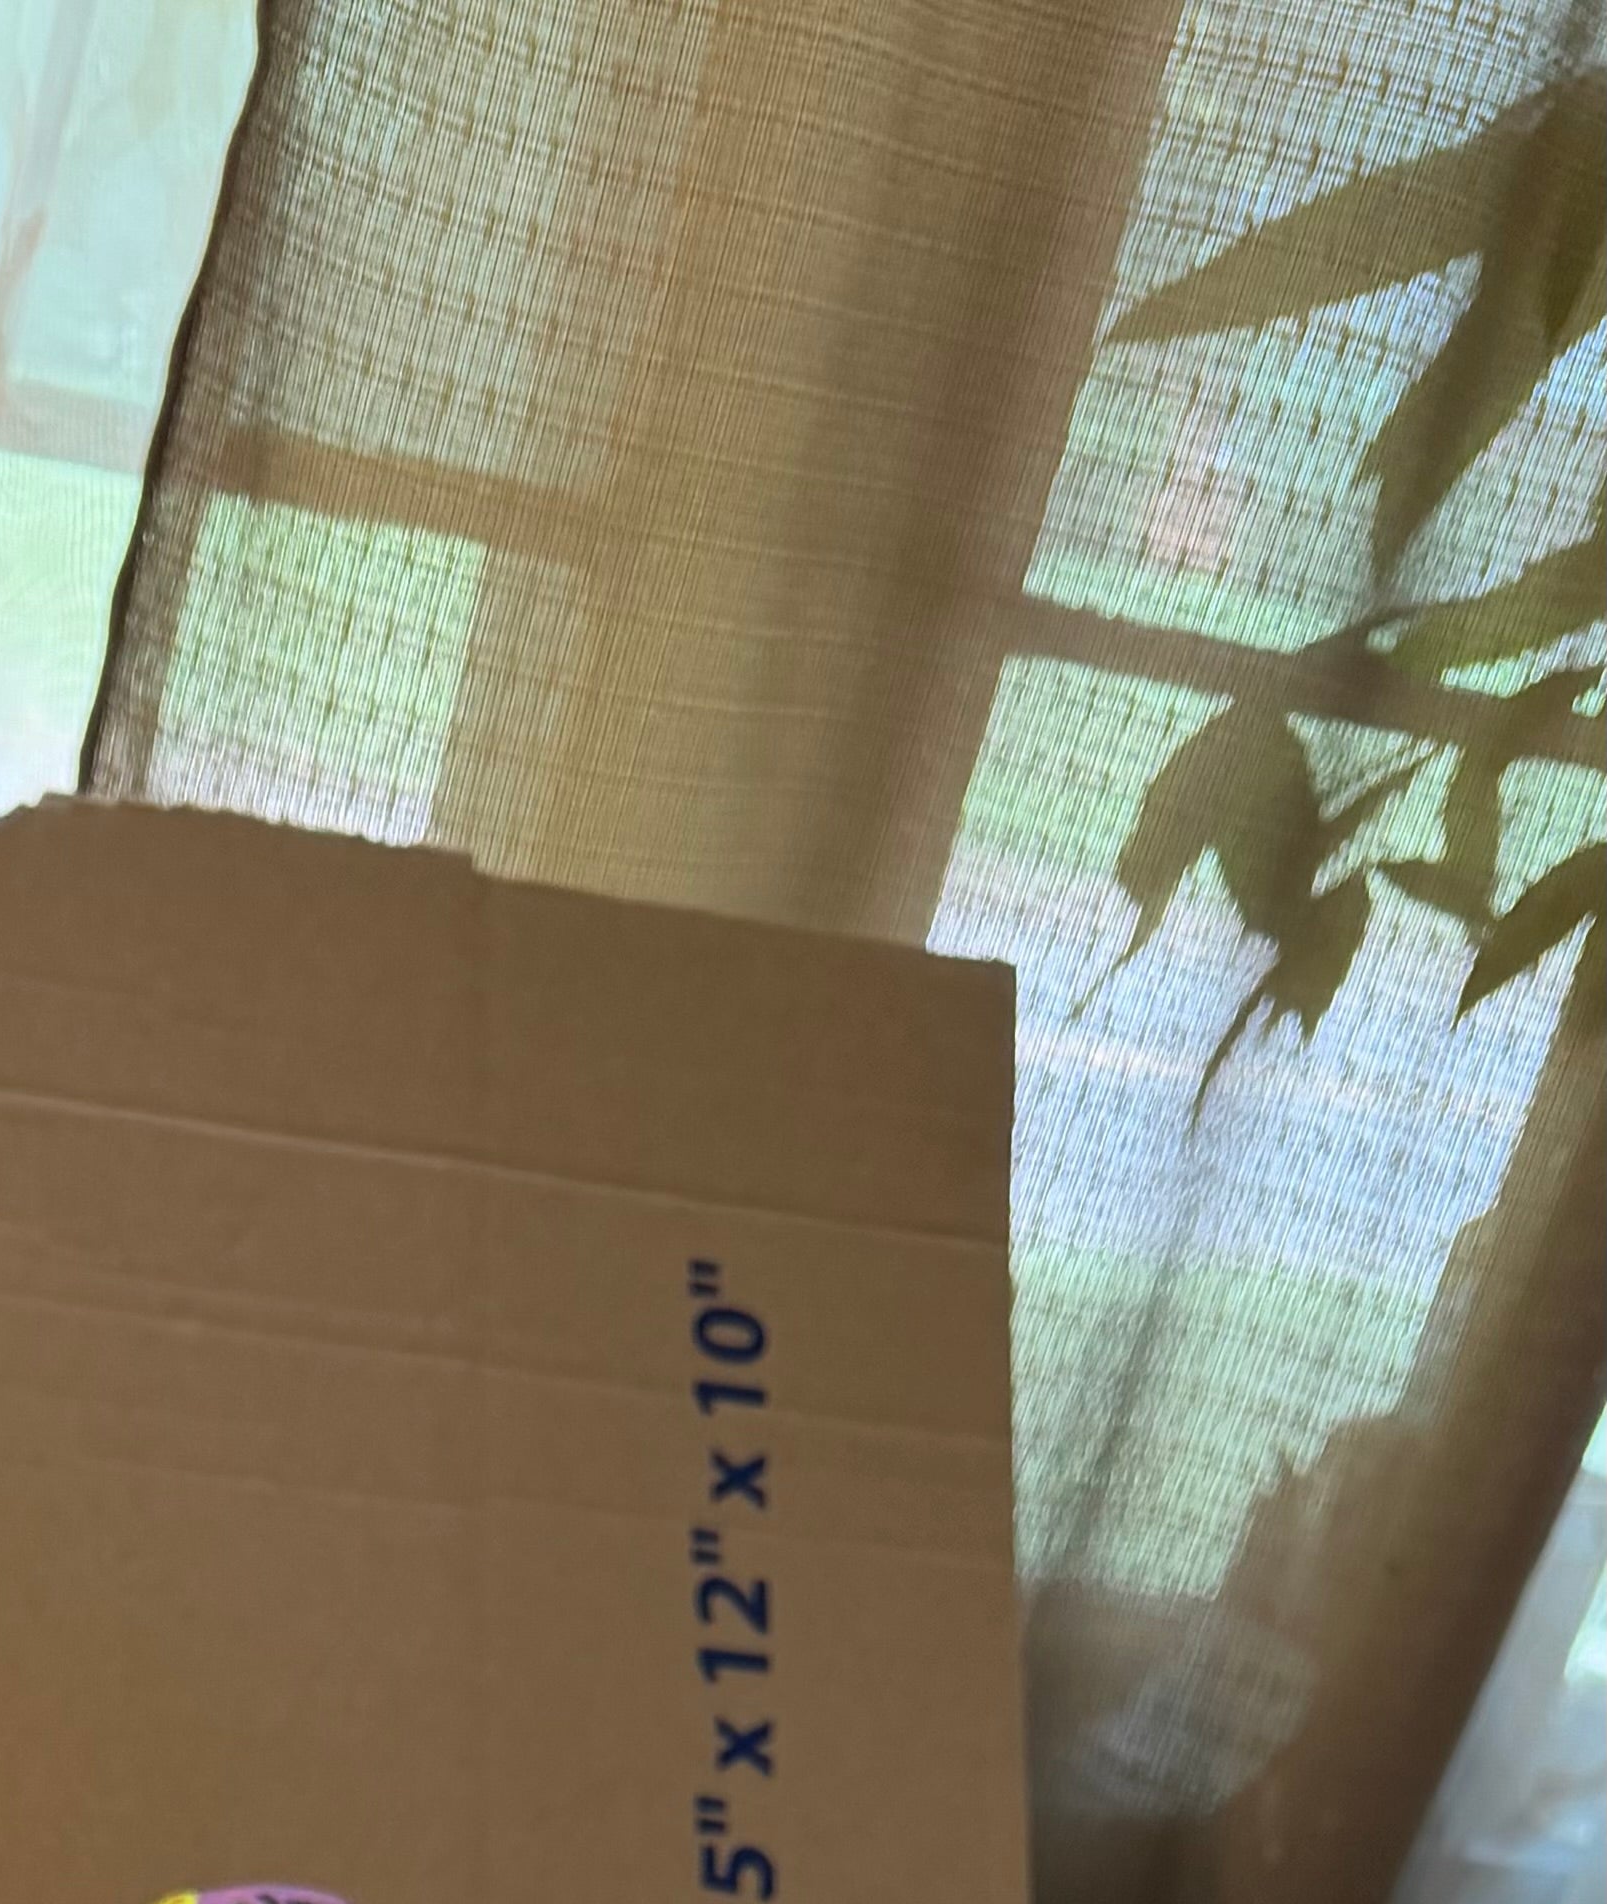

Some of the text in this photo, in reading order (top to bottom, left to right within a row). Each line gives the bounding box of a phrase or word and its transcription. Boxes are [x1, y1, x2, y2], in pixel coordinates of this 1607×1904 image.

[688, 1259, 768, 1415] 10"
[709, 1449, 768, 1509] x
[690, 1528, 772, 1684] 12"
[714, 1716, 775, 1777] x
